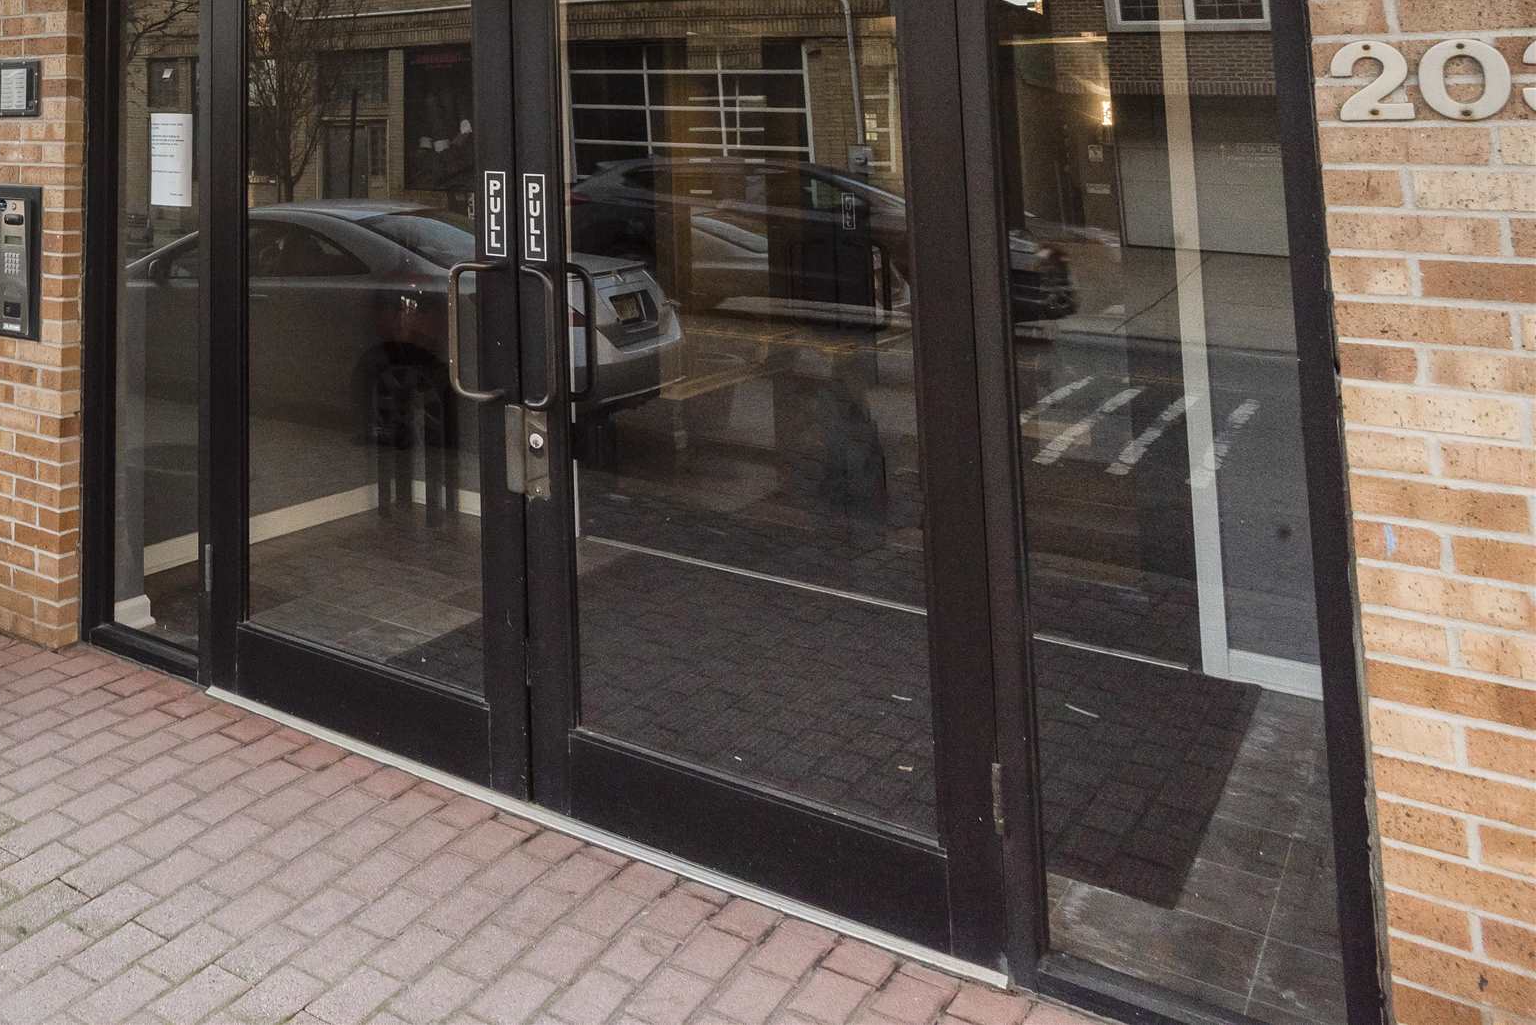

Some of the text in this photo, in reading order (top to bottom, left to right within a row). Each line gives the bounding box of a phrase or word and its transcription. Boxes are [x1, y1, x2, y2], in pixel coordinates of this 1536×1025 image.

[1330, 38, 1536, 122] 20
[489, 179, 501, 248] PULL
[528, 182, 541, 253] PULL
